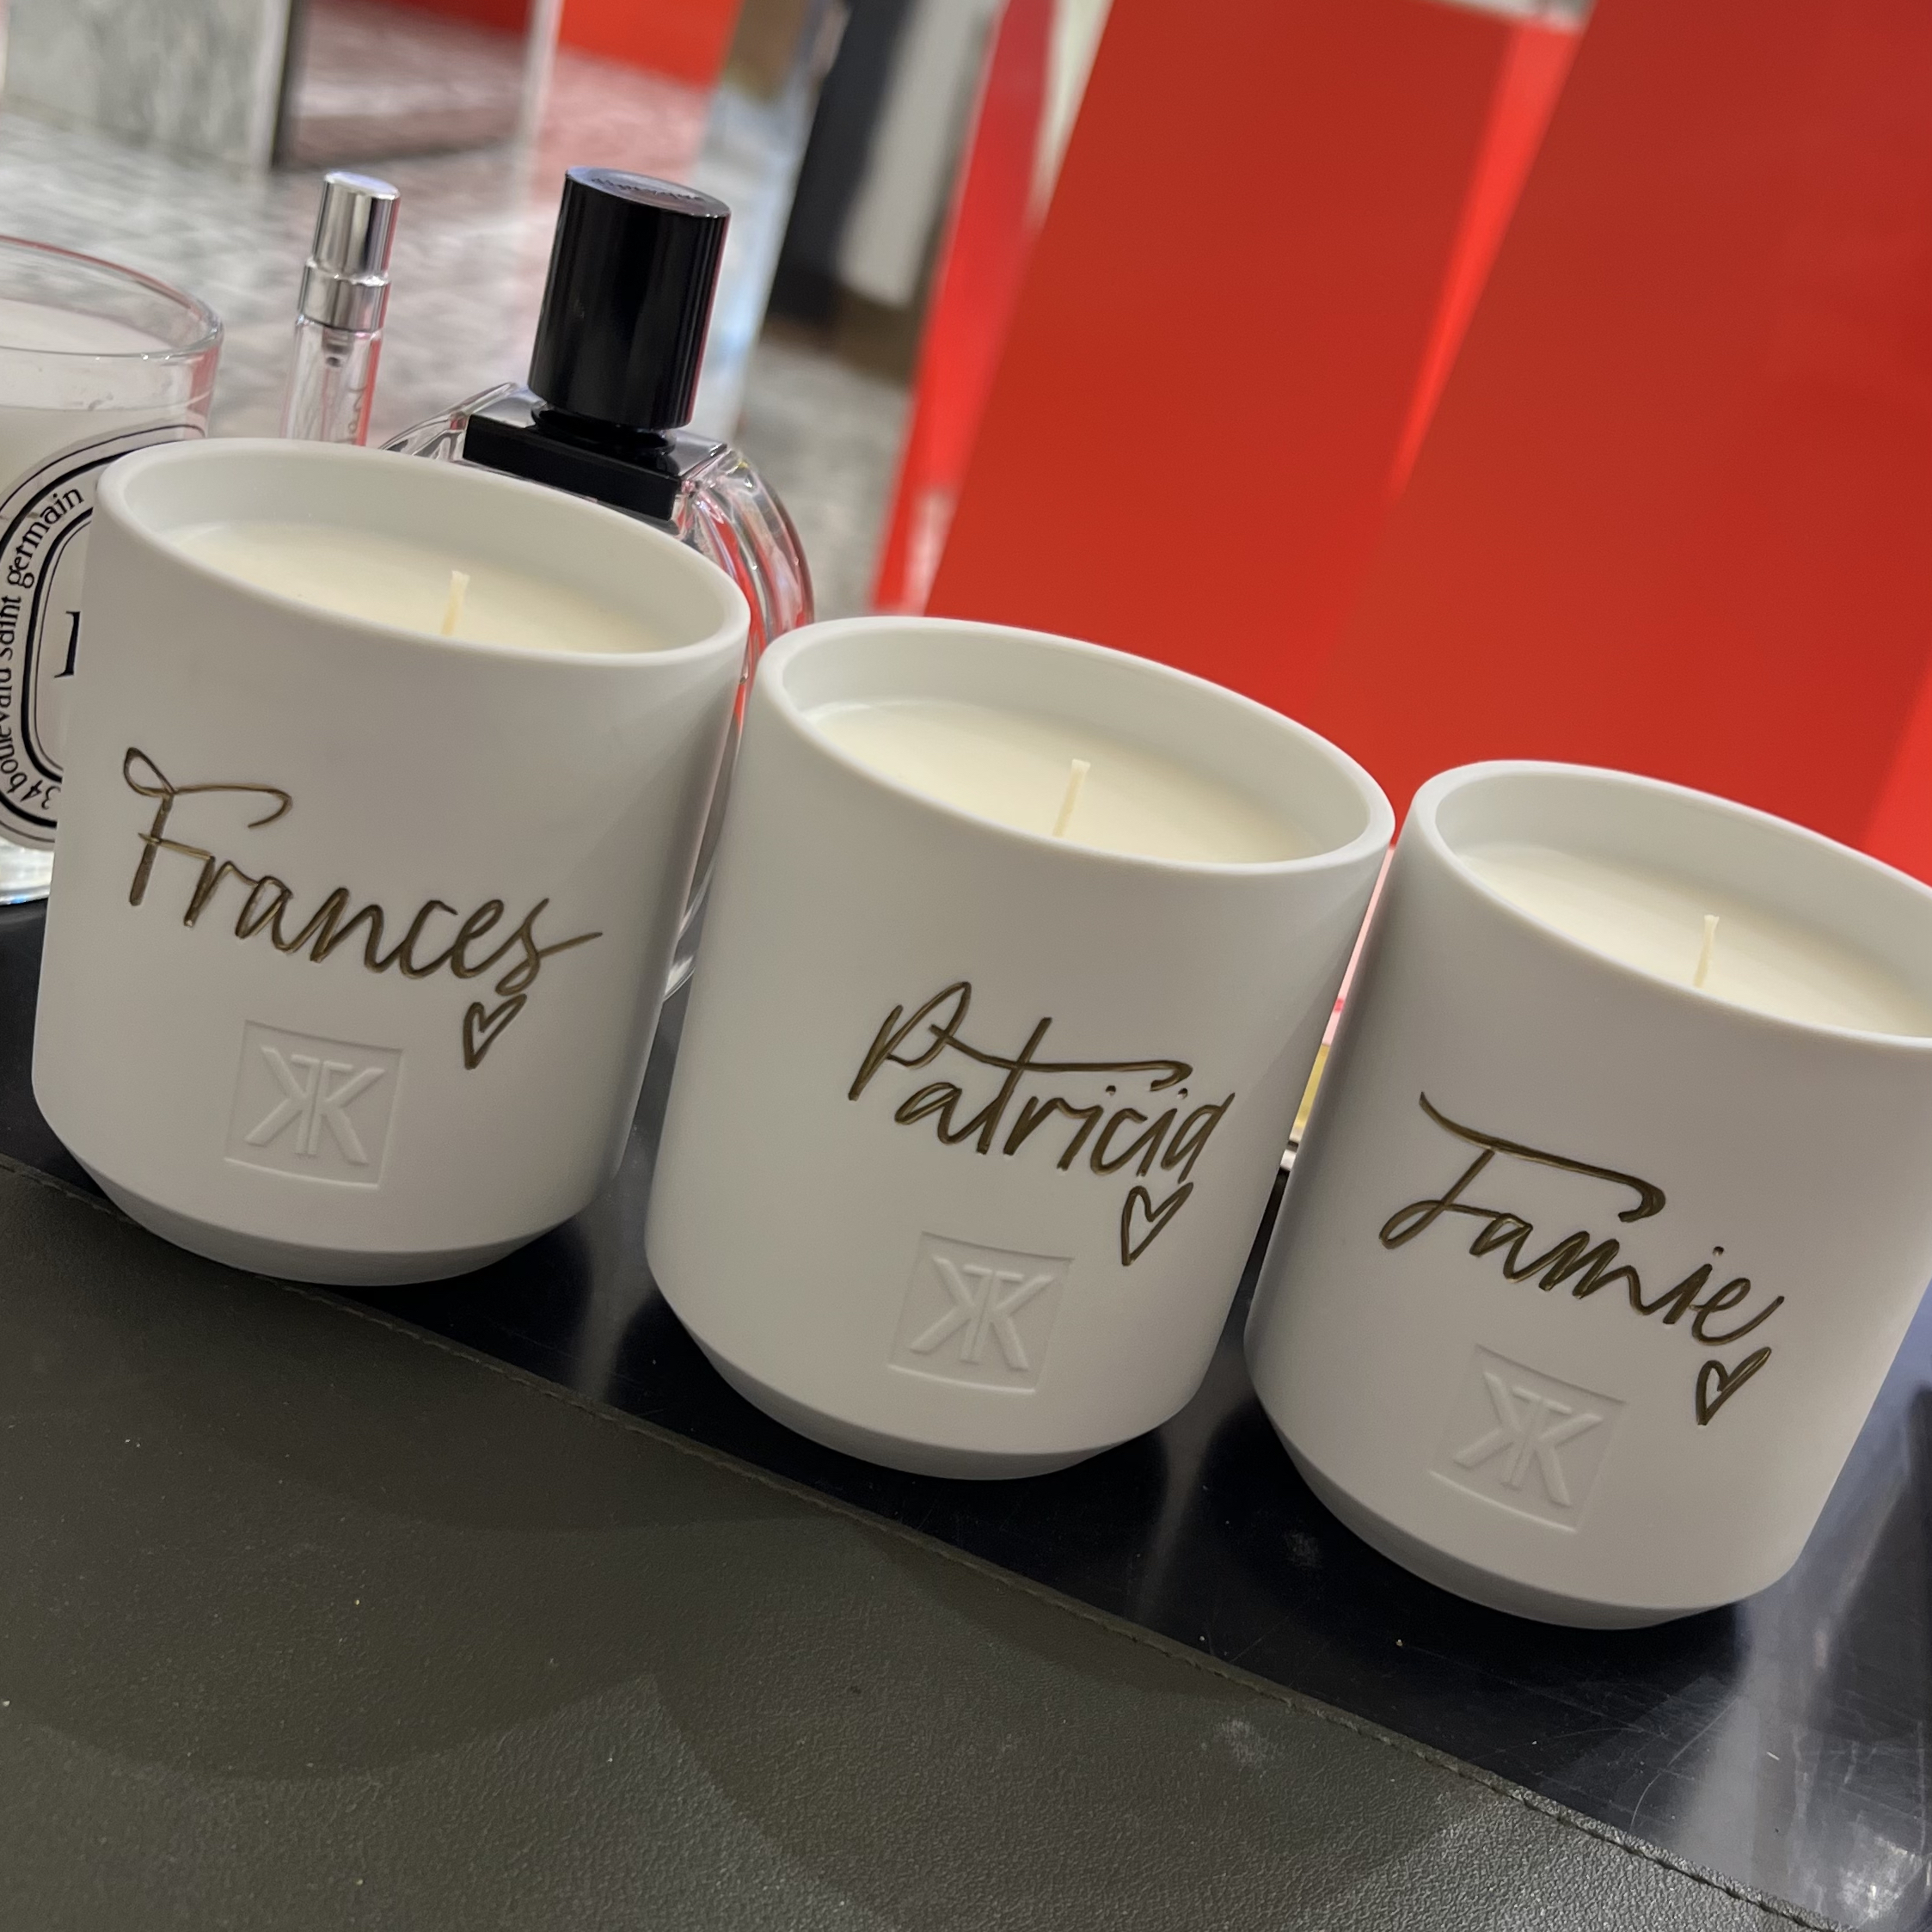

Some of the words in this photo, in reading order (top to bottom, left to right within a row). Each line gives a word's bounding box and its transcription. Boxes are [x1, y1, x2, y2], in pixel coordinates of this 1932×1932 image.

[7, 488, 84, 589] germain
[0, 596, 21, 661] saint
[21, 780, 61, 810] 34
[123, 747, 603, 996] Frances
[848, 981, 1236, 1184] Patricia
[1378, 1091, 1785, 1346] Jamie
